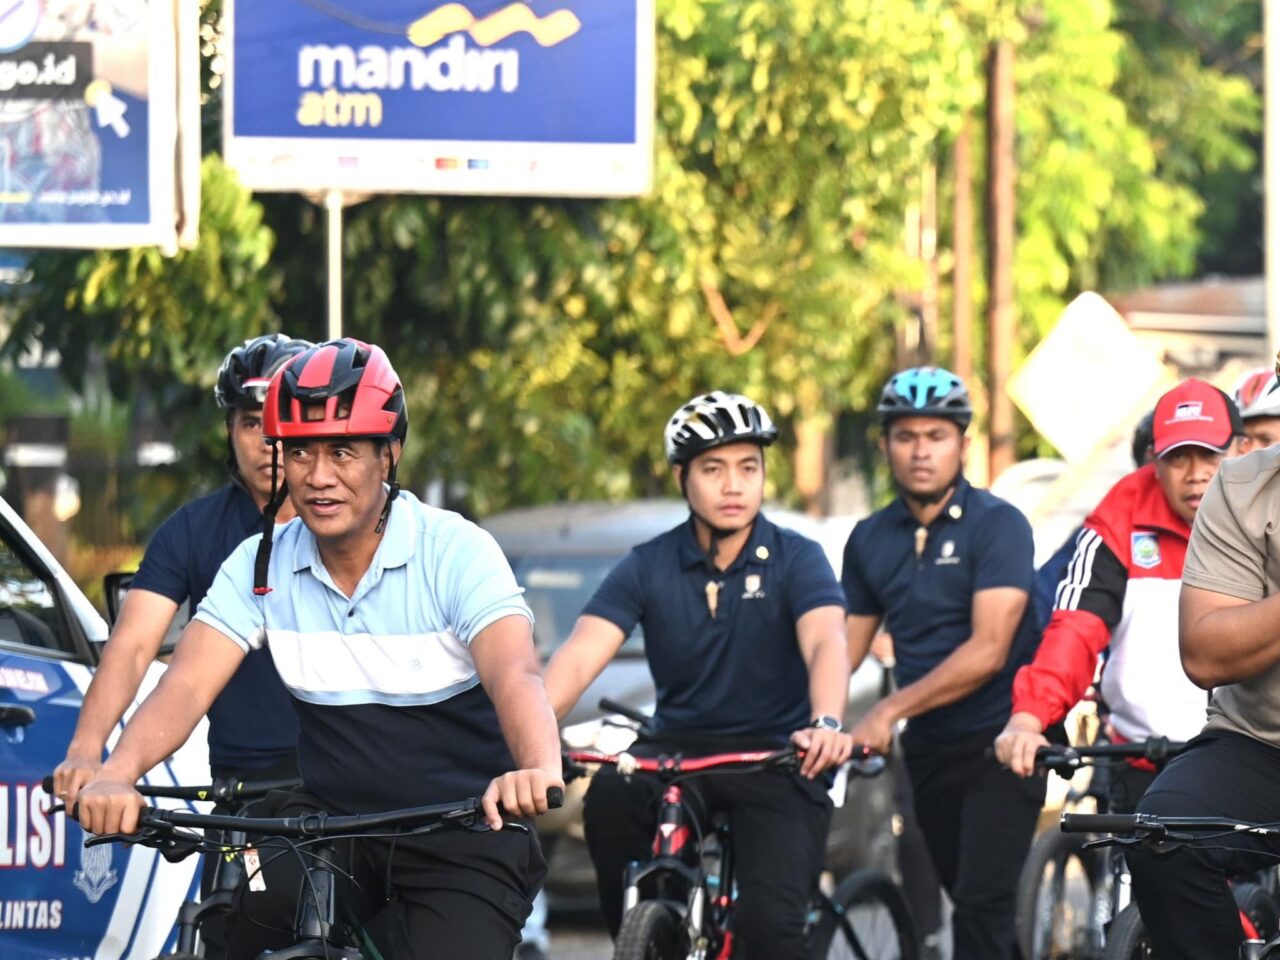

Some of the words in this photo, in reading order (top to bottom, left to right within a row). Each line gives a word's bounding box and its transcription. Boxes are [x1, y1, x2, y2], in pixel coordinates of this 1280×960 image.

[298, 34, 519, 93] mandiri
[296, 87, 383, 127] atm
[0, 899, 62, 930] INTAS
